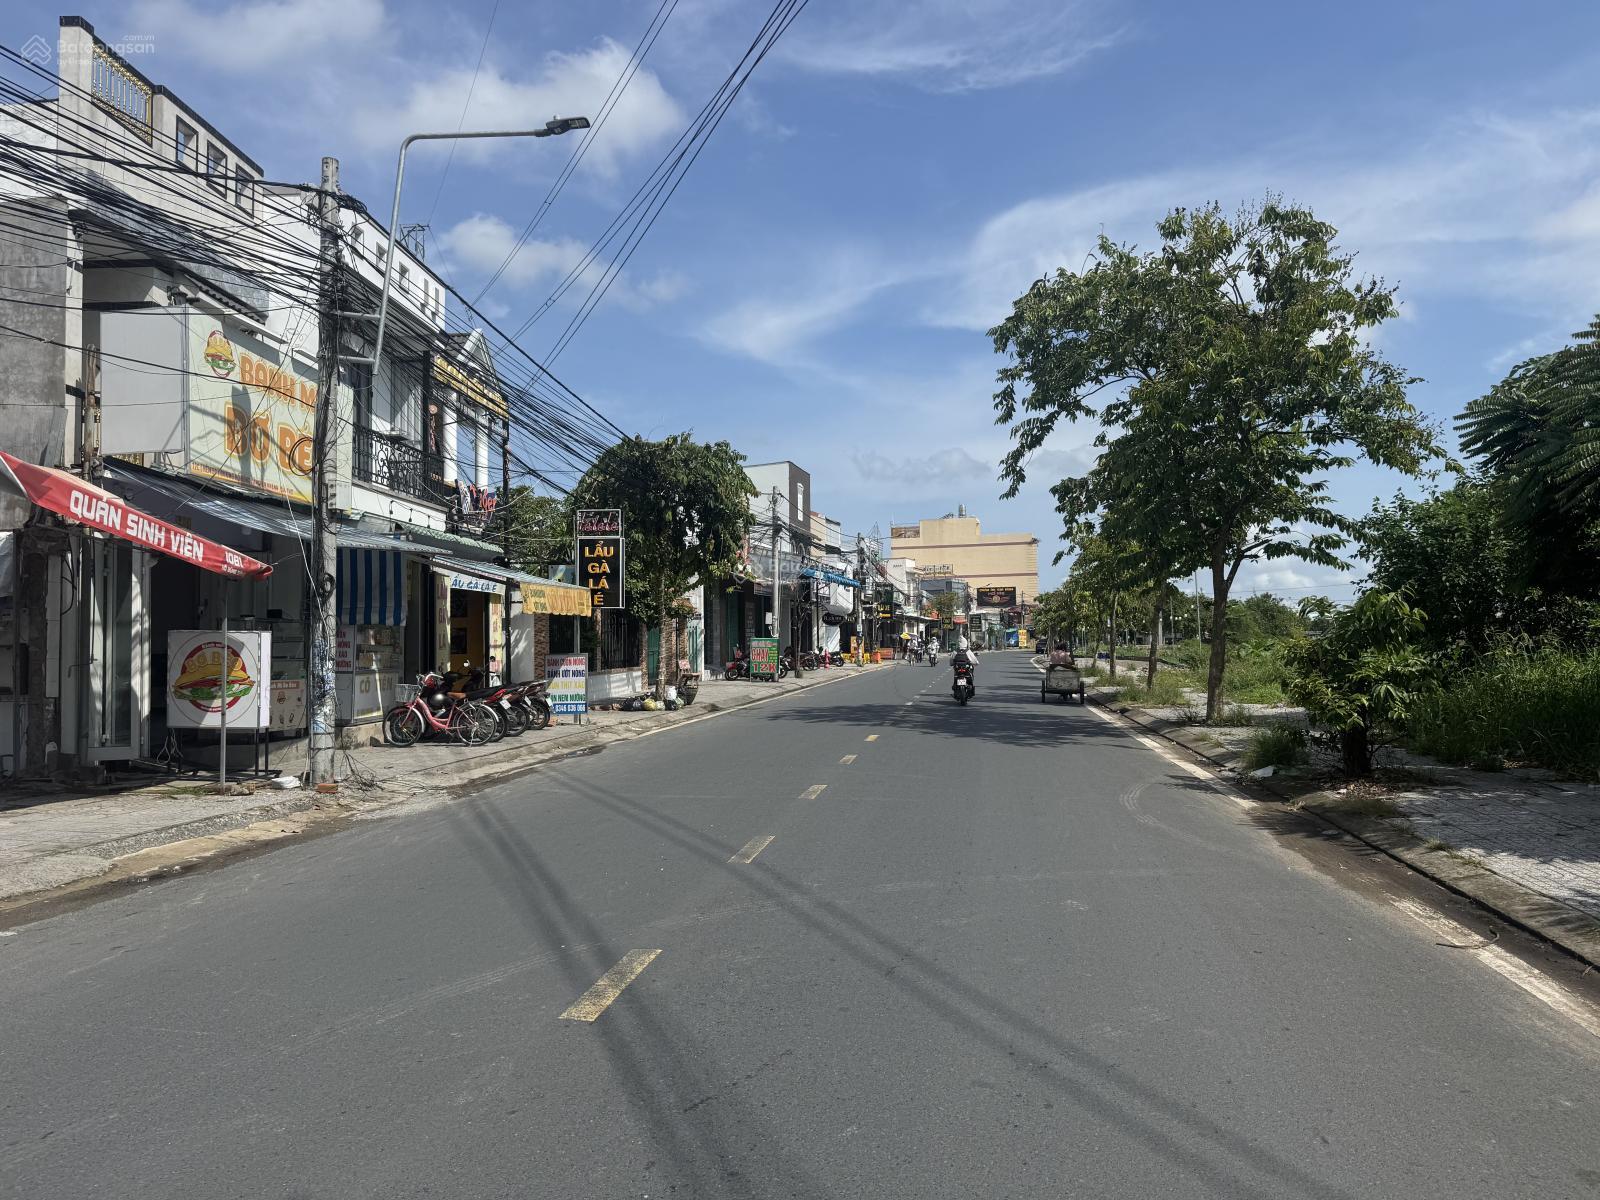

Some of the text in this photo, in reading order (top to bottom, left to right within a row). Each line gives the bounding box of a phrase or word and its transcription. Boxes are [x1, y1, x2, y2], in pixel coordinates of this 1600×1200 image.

[69, 489, 204, 562] QUÁN SINH VIÊN
[584, 541, 614, 557] LẨU
[588, 560, 610, 573] GÀ
[588, 576, 609, 589] LÁ
[594, 592, 604, 605] É
[752, 648, 768, 662] CHAY
[753, 663, 776, 672] 12K
